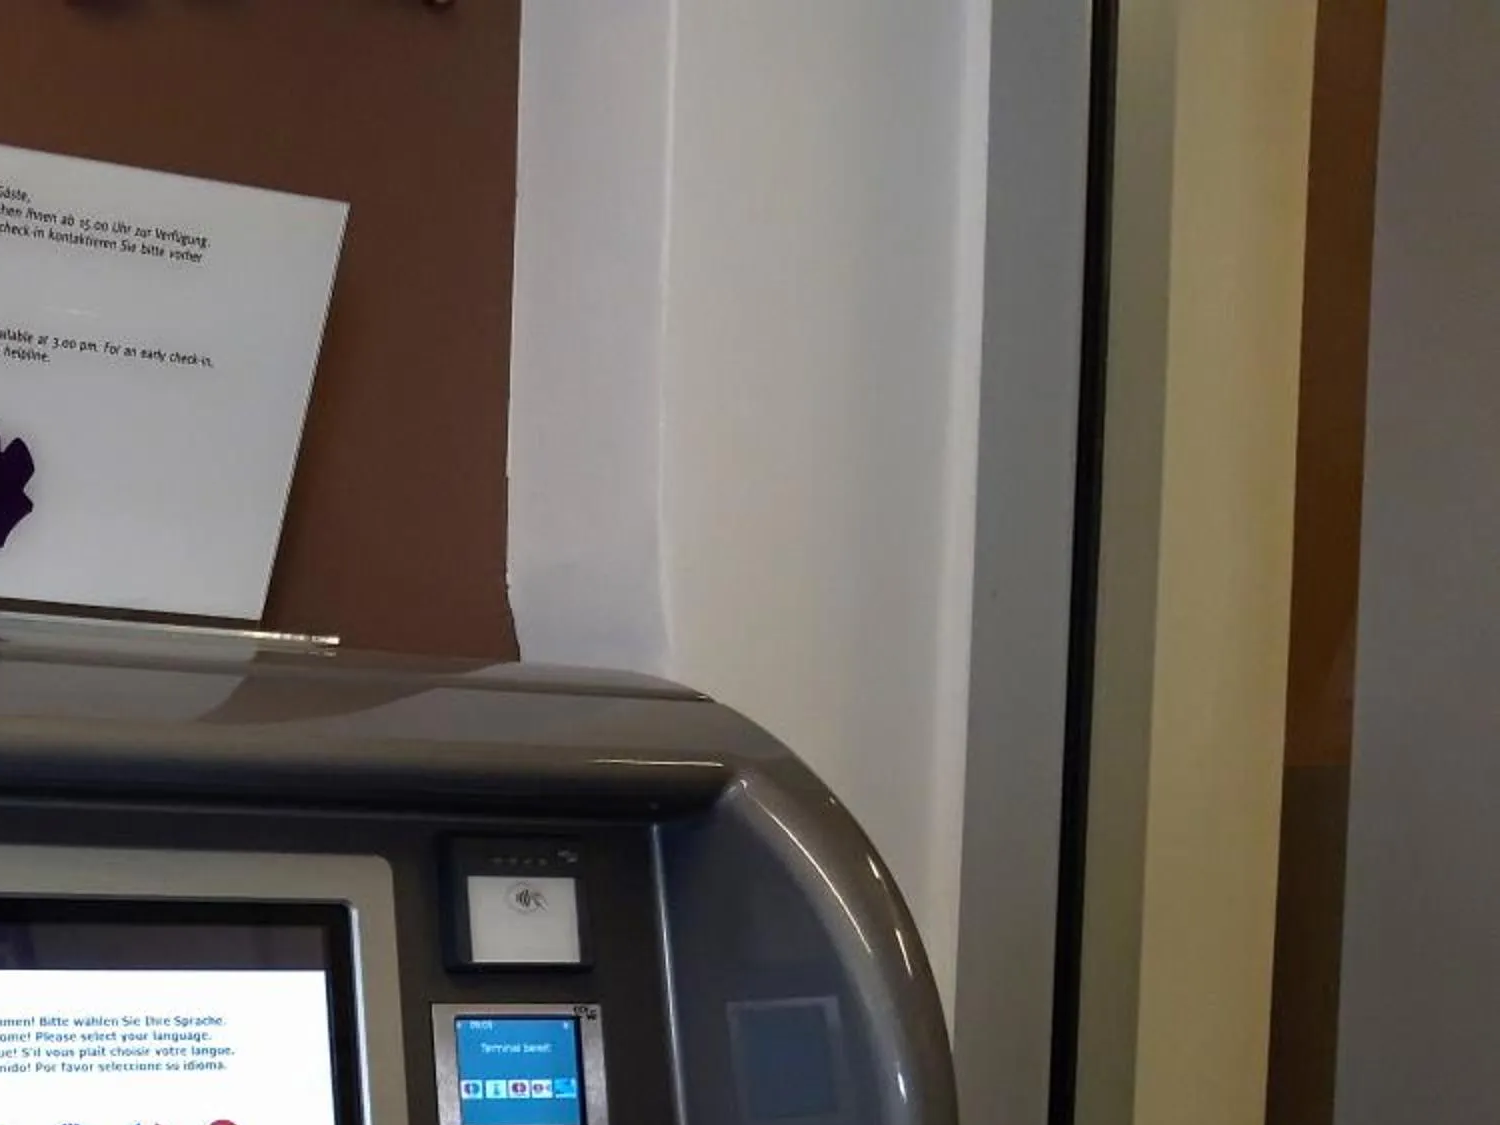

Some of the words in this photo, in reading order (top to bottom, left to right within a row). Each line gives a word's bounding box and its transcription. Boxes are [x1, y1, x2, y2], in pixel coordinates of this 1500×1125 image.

[60, 213, 76, 226] ab
[112, 221, 132, 234] Uhr
[134, 226, 152, 238] zur
[120, 239, 137, 252] Sie
[141, 243, 165, 257] bitte
[169, 250, 203, 263] vorher
[37, 335, 49, 345] at
[103, 341, 122, 356] For
[124, 346, 137, 357] an
[140, 348, 167, 363] early
[40, 1016, 69, 1027] Bitte
[122, 1016, 140, 1027] Sie
[145, 1016, 171, 1026] Ihre
[35, 1031, 77, 1042] Please
[81, 1030, 117, 1042] select
[121, 1032, 148, 1042] your
[45, 1048, 75, 1057] vous
[110, 1046, 150, 1057] choisir
[155, 1047, 186, 1057] votre
[35, 1062, 57, 1073] Por
[61, 1061, 94, 1073] favor
[98, 1060, 164, 1072] seleccione
[166, 1062, 180, 1071] su
